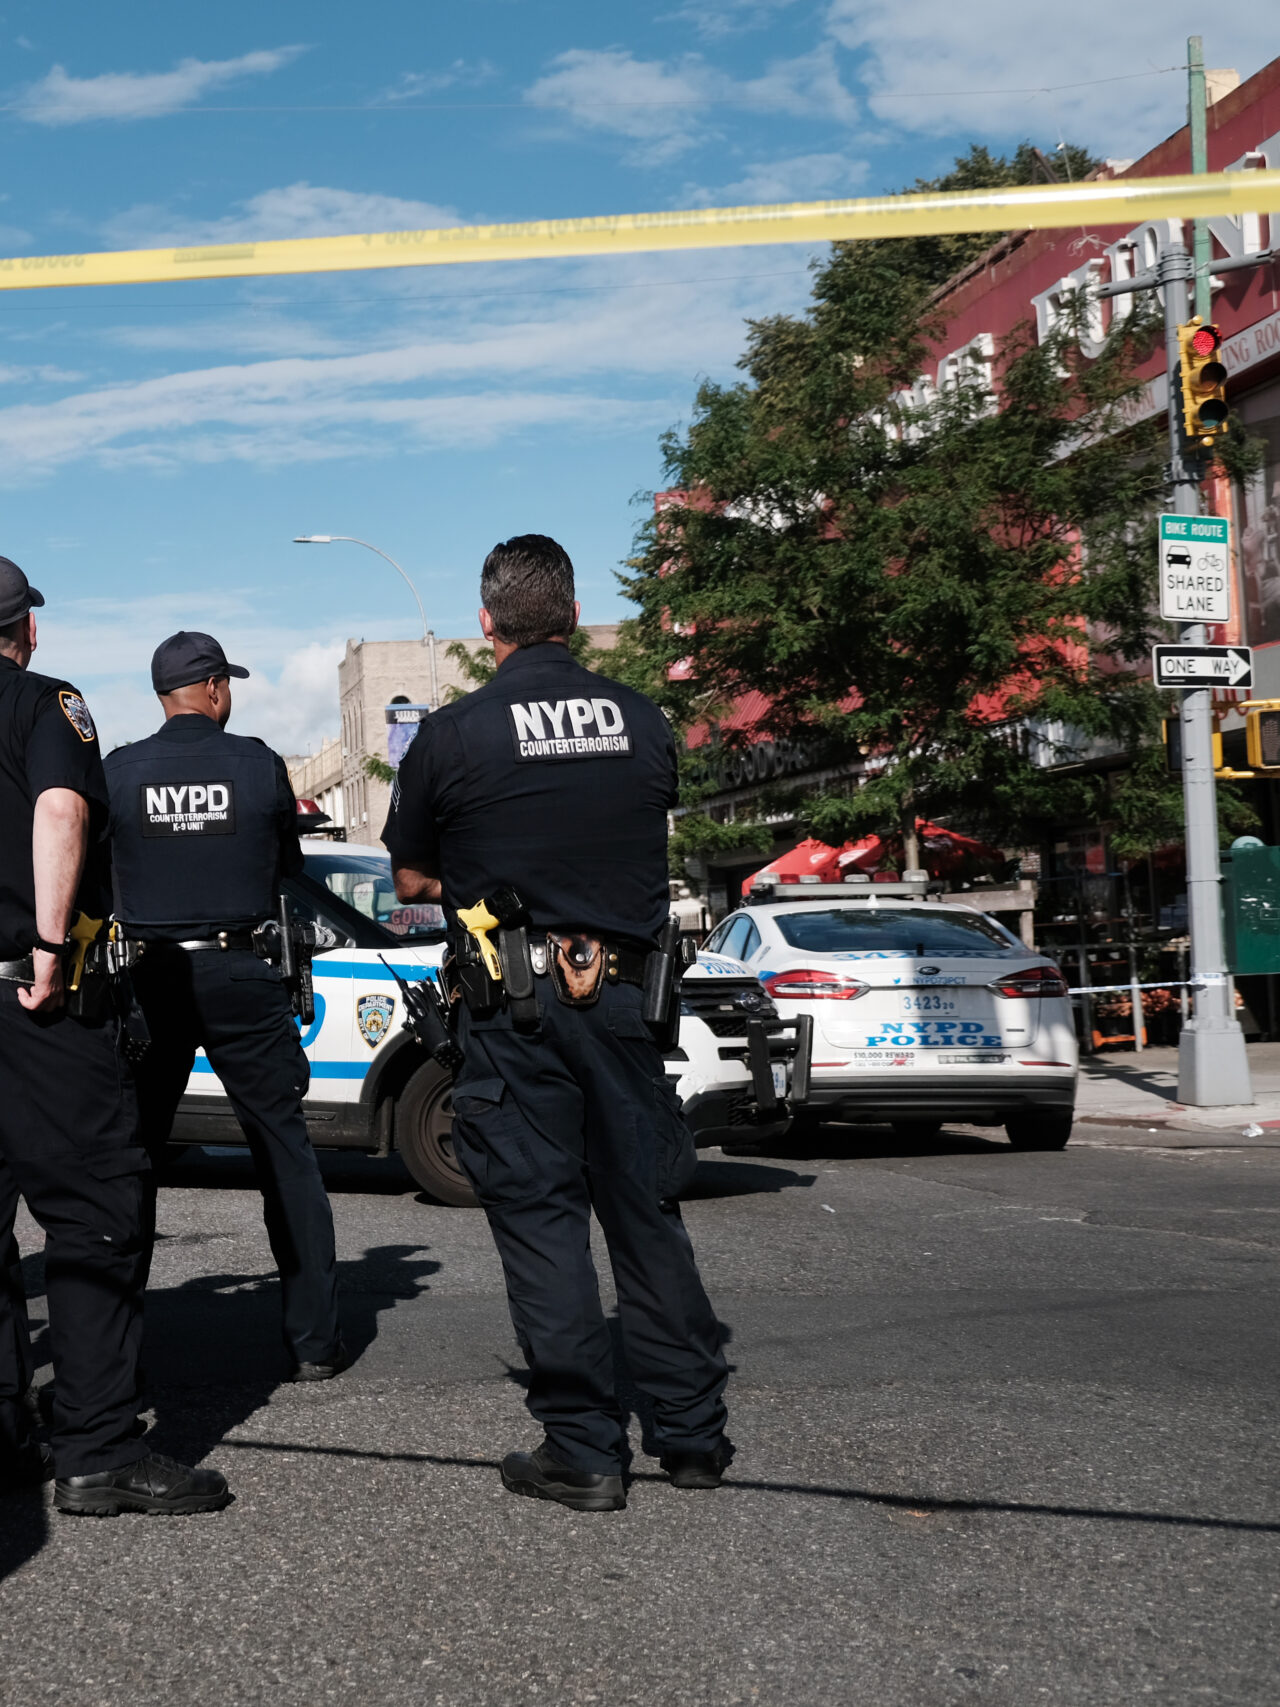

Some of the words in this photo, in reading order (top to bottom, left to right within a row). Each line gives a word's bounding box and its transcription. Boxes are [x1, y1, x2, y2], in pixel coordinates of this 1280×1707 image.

[1165, 522, 1187, 535] BIKE
[1191, 524, 1223, 538] ROUTE
[1167, 574, 1223, 592] SHARED
[1177, 596, 1214, 612] LANE
[1165, 659, 1196, 674] ONE
[1212, 659, 1239, 674] WAY
[510, 698, 625, 741] NYPD
[519, 735, 630, 757] COUNTERTERRORISM
[146, 784, 229, 814] NYPD
[149, 811, 227, 823] COUNTERTERRORISM
[173, 823, 186, 831] K-9
[187, 822, 204, 830] UNIT
[904, 996, 941, 1010] 3423
[880, 1022, 984, 1034] NYPD
[865, 1034, 1002, 1047] POLICE
